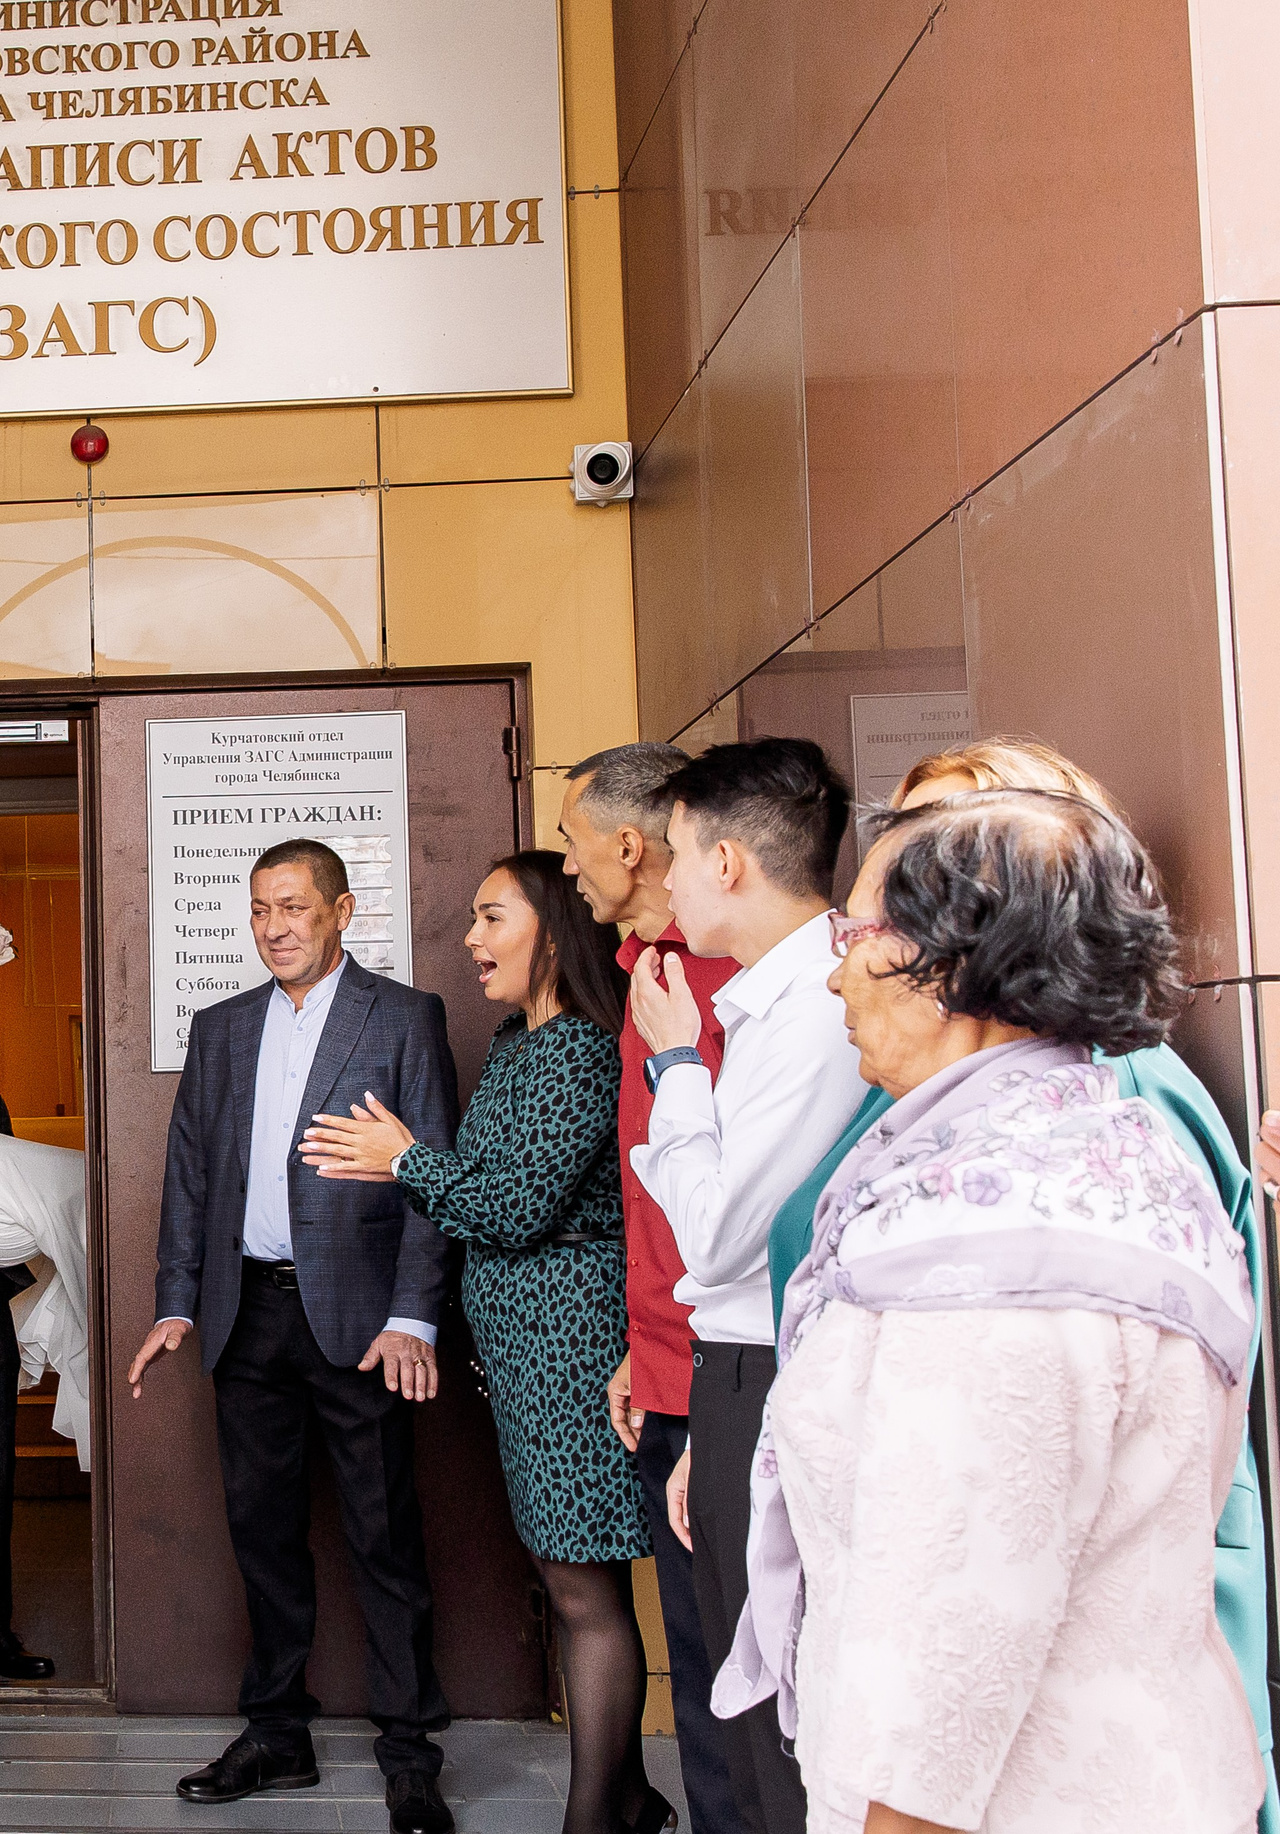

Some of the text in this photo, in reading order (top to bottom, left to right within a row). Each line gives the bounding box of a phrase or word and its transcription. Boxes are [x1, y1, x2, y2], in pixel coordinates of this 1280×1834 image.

[191, 26, 370, 67] РАЙОНА
[27, 76, 330, 121] ЧЕЛЯБИНСКА
[229, 125, 439, 181] АКТОВ
[153, 197, 545, 262] СОСТОЯНИЯ
[211, 730, 344, 747] Курчатовский отдел
[162, 749, 393, 767] Управления ЗАГС Администрации
[215, 769, 340, 785] города Челябинска
[172, 805, 383, 825] ПРИЕМ ГРАЖДАН:
[173, 845, 269, 859] Понедельни
[173, 872, 241, 887] Вторник
[174, 898, 222, 914] Среда
[174, 925, 238, 940] Четверг
[175, 951, 244, 964] Пятница
[175, 977, 240, 994] Суббота
